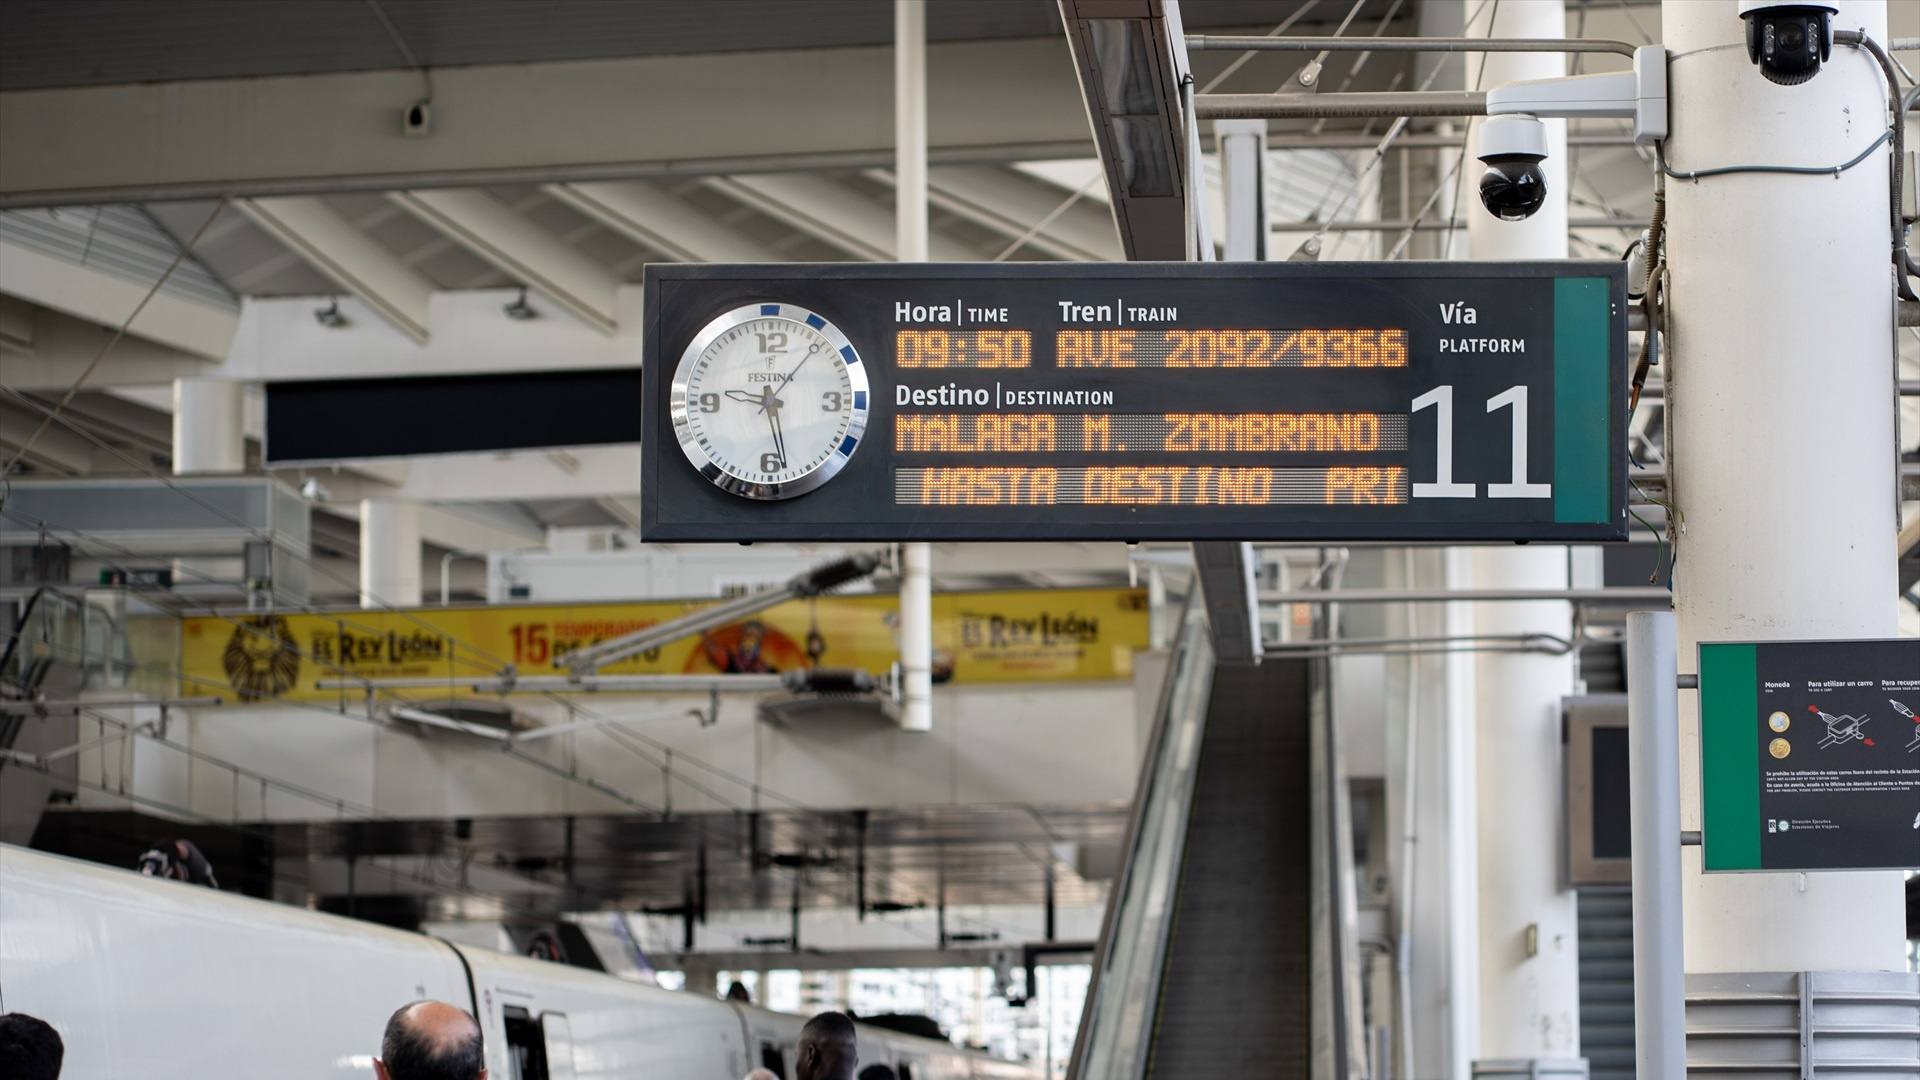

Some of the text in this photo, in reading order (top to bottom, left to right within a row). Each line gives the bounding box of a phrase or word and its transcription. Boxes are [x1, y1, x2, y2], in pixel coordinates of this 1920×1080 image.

[895, 302, 1008, 323] Hora TIME
[1058, 301, 1177, 322] Tren TRAIN
[1439, 301, 1477, 324] Vía
[754, 332, 788, 353] 12
[896, 330, 1029, 368] 09:50
[1057, 329, 1405, 368] AVE 2092/9366
[1439, 339, 1525, 353] PLATFORM
[747, 373, 794, 382] FESTINA
[700, 393, 720, 413] 9
[821, 392, 842, 412] 3
[896, 382, 1114, 406] Destino DESTINATION
[1084, 414, 1126, 451] M.
[1164, 413, 1379, 451] ZAMBRANO
[1411, 385, 1552, 498] 11
[760, 453, 780, 473] 6
[922, 466, 1401, 505] HASTA DESTINO PRI
[508, 622, 549, 665] 15
[1765, 681, 1791, 689] Moneda
[1823, 680, 1846, 688] utilizar
[1881, 679, 1896, 687] Para
